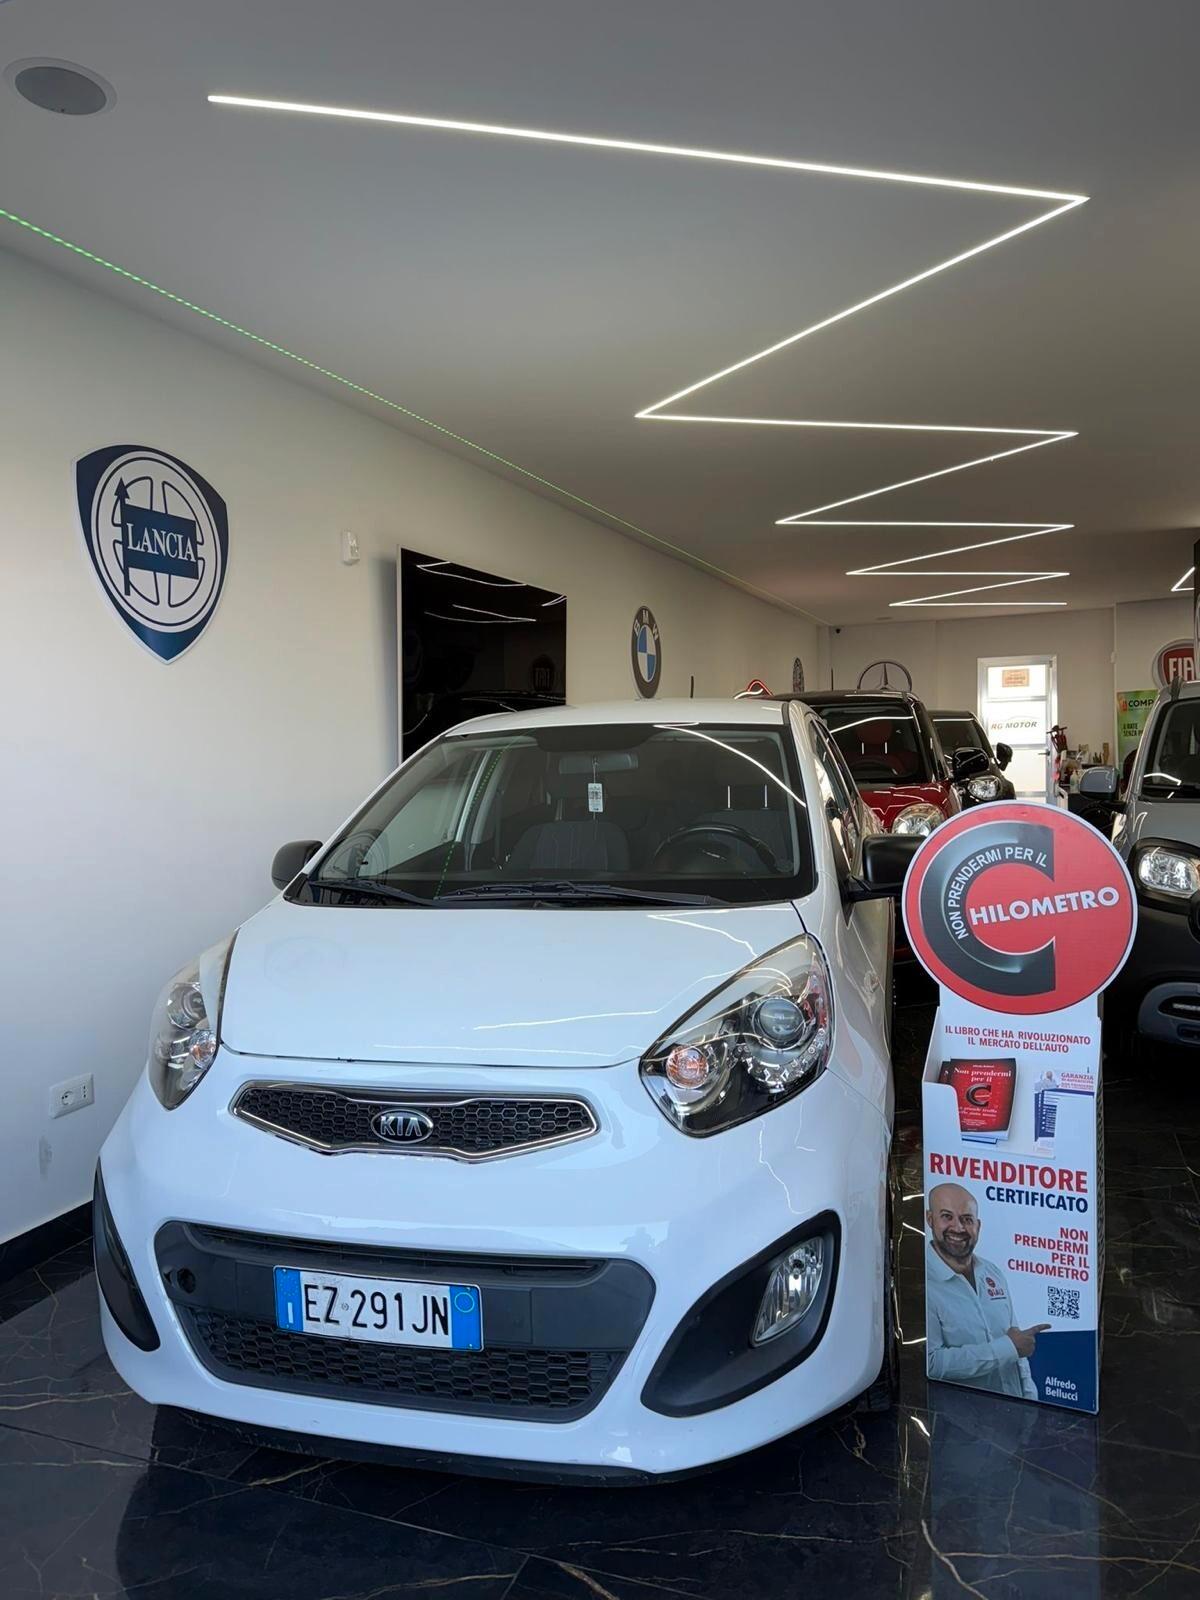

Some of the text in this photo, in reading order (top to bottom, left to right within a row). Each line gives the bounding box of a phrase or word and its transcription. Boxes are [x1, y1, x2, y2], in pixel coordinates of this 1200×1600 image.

[127, 523, 196, 562] LANCIA
[1168, 657, 1195, 682] FIA
[1128, 699, 1154, 707] COMP
[1005, 721, 1038, 729] MOTOR
[948, 846, 1048, 940] NON PRENDERMI PER IL
[945, 1025, 1091, 1045] IL LIBRO CHE HA RIVOLUZIONATO
[968, 1037, 1069, 1053] IL MERCATO DELL'AUTO
[381, 1115, 422, 1136] KIA
[930, 1153, 1088, 1193] RIVENDITORE
[985, 1186, 1088, 1213] CERTIFICATO
[1014, 1233, 1089, 1255] PRENDERMI
[1060, 1227, 1088, 1242] NON
[1007, 1258, 1089, 1282] CHILOMETRO
[1051, 1252, 1089, 1268] PER IL
[1045, 1376, 1076, 1390] Alfredo
[1045, 1387, 1078, 1401] Bellucci
